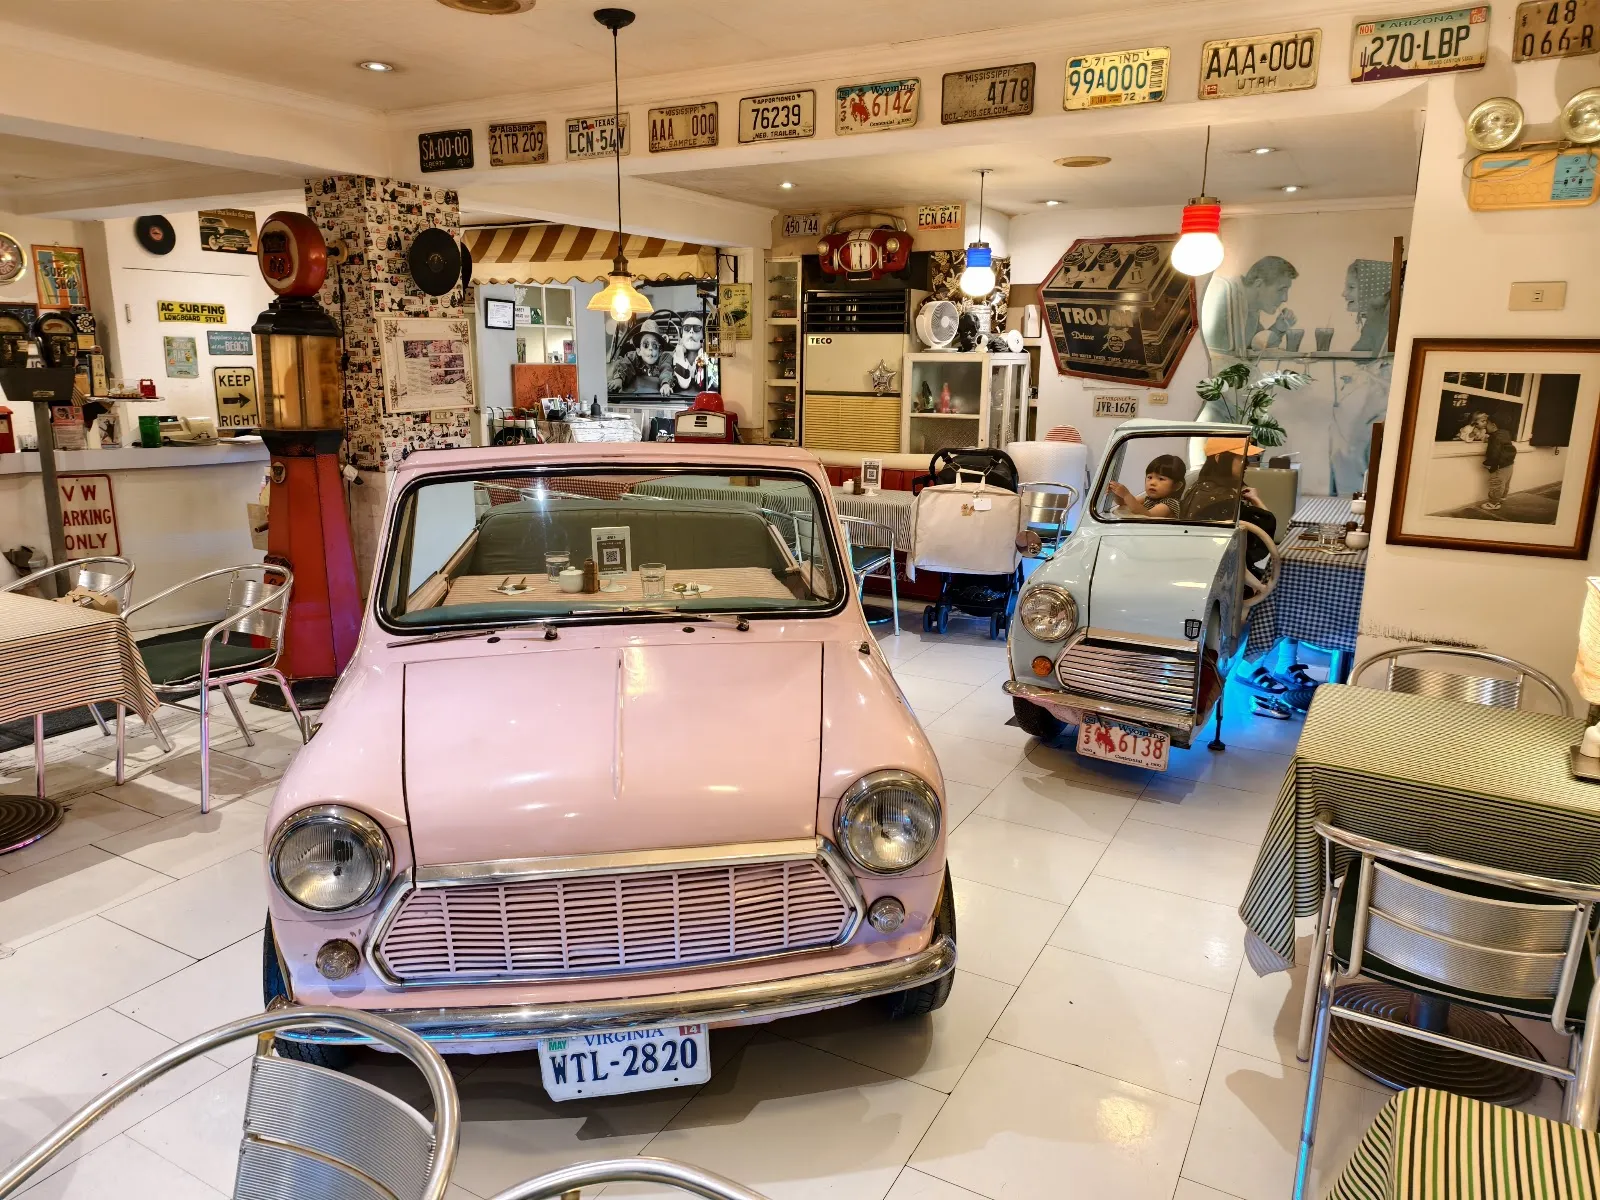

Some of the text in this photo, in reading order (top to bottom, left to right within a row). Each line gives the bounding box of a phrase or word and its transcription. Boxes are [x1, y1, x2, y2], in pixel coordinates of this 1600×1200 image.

[1547, 0, 1577, 25] 48
[1360, 25, 1374, 34] NOV
[1389, 15, 1454, 29] ARIZONA
[1205, 45, 1256, 80] AAA
[1269, 37, 1314, 71] 000
[965, 69, 1011, 83] MISSISSIPPI
[1069, 63, 1148, 96] 99A000
[1237, 76, 1277, 90] UTAH
[870, 83, 917, 95] Wyoming
[987, 79, 1029, 106] 4778
[756, 95, 796, 105] APPORTIONED
[872, 90, 914, 117] 6142
[1123, 93, 1136, 102] 72
[594, 118, 615, 128] TEXAS
[751, 104, 801, 131] 76239
[500, 124, 535, 134] Alabama
[651, 113, 715, 143] AAA 000
[770, 129, 797, 138] TRAILER
[522, 131, 544, 153] 209
[568, 131, 594, 154] LCN
[918, 210, 957, 226] ECN 641
[785, 218, 818, 235] 450 744
[160, 302, 225, 314] AC SURFING
[164, 313, 200, 322] LONGBOARD
[1060, 307, 1134, 328] TROJAN
[225, 340, 249, 352] BEACH
[810, 337, 833, 345] TECO
[218, 375, 251, 387] KEEP
[221, 414, 257, 427] RIGHT
[63, 508, 112, 527] ARKING
[64, 532, 107, 551] ONLY
[1119, 724, 1166, 744] Wyoming
[1118, 732, 1163, 760] 6138
[584, 1027, 665, 1047] VIRGINIA
[683, 1026, 698, 1035] 14
[548, 1040, 567, 1051] MAY
[549, 1037, 699, 1085] WTL-2820
